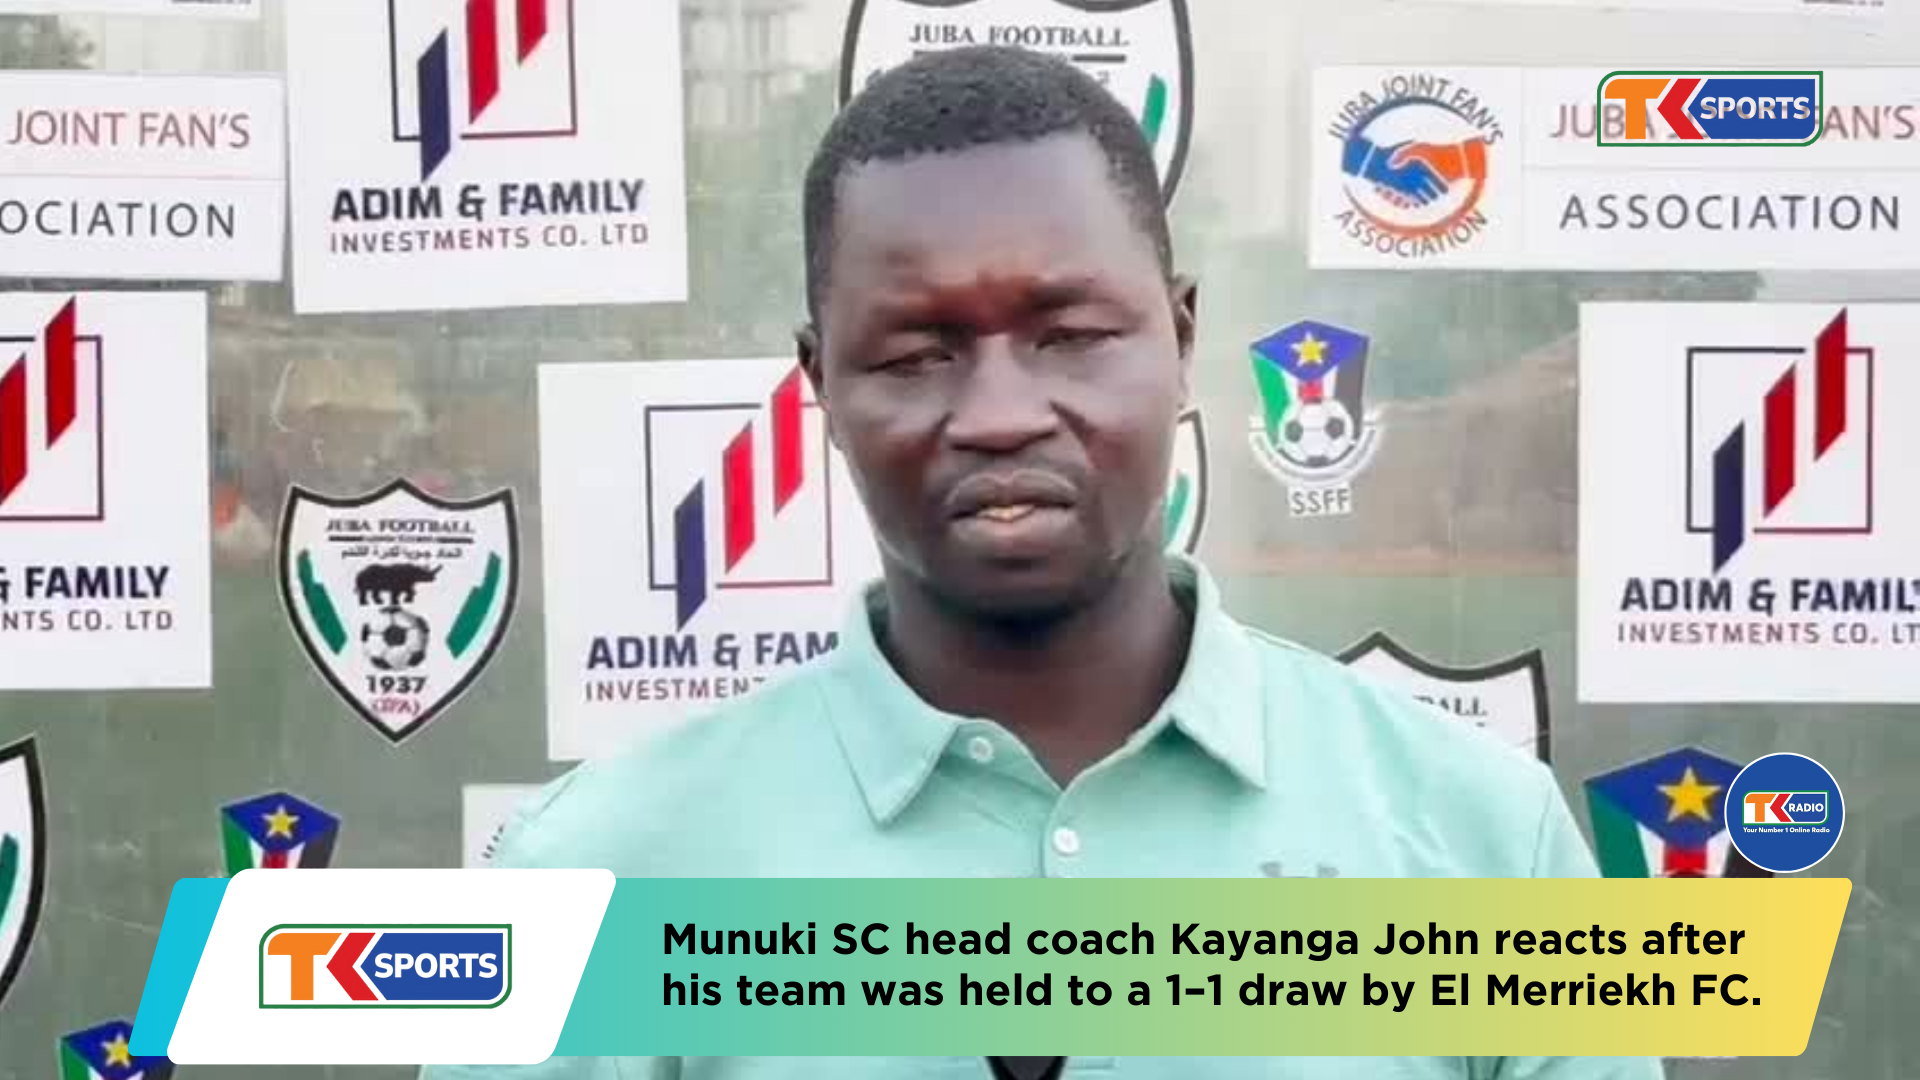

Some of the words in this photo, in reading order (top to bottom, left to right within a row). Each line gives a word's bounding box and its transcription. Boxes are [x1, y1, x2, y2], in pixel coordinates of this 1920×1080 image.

[909, 24, 975, 43] JUBA
[989, 26, 1129, 46] FOOTBALL
[1328, 90, 1377, 140] JUBA
[1382, 73, 1450, 99] JOINT
[8, 110, 126, 146] JOINT
[139, 112, 251, 149] FAN'S
[331, 185, 442, 221] ADIM
[457, 184, 486, 221] &
[500, 179, 645, 215] FAMILY
[1559, 193, 1899, 231] ASSOCIATION
[330, 227, 530, 253] INVESTMENTS
[543, 225, 587, 247] CO.
[602, 223, 648, 244] LTD
[1333, 208, 1488, 258] ASSOCIATION
[1291, 488, 1349, 515] SSFF
[327, 519, 371, 532] JUBA
[379, 519, 475, 533] FOOTBALL
[25, 566, 169, 599] FAMILY
[1620, 578, 1732, 612] ADIM
[1749, 578, 1776, 617] &
[68, 610, 112, 630] CO.
[126, 610, 173, 630] LTD
[1617, 622, 1820, 644] INVESTMENTS
[1833, 622, 1879, 644] CO.
[587, 634, 698, 669] ADIM
[713, 633, 741, 671] &
[366, 675, 427, 693] 1937
[585, 676, 765, 701] INVESTMEN
